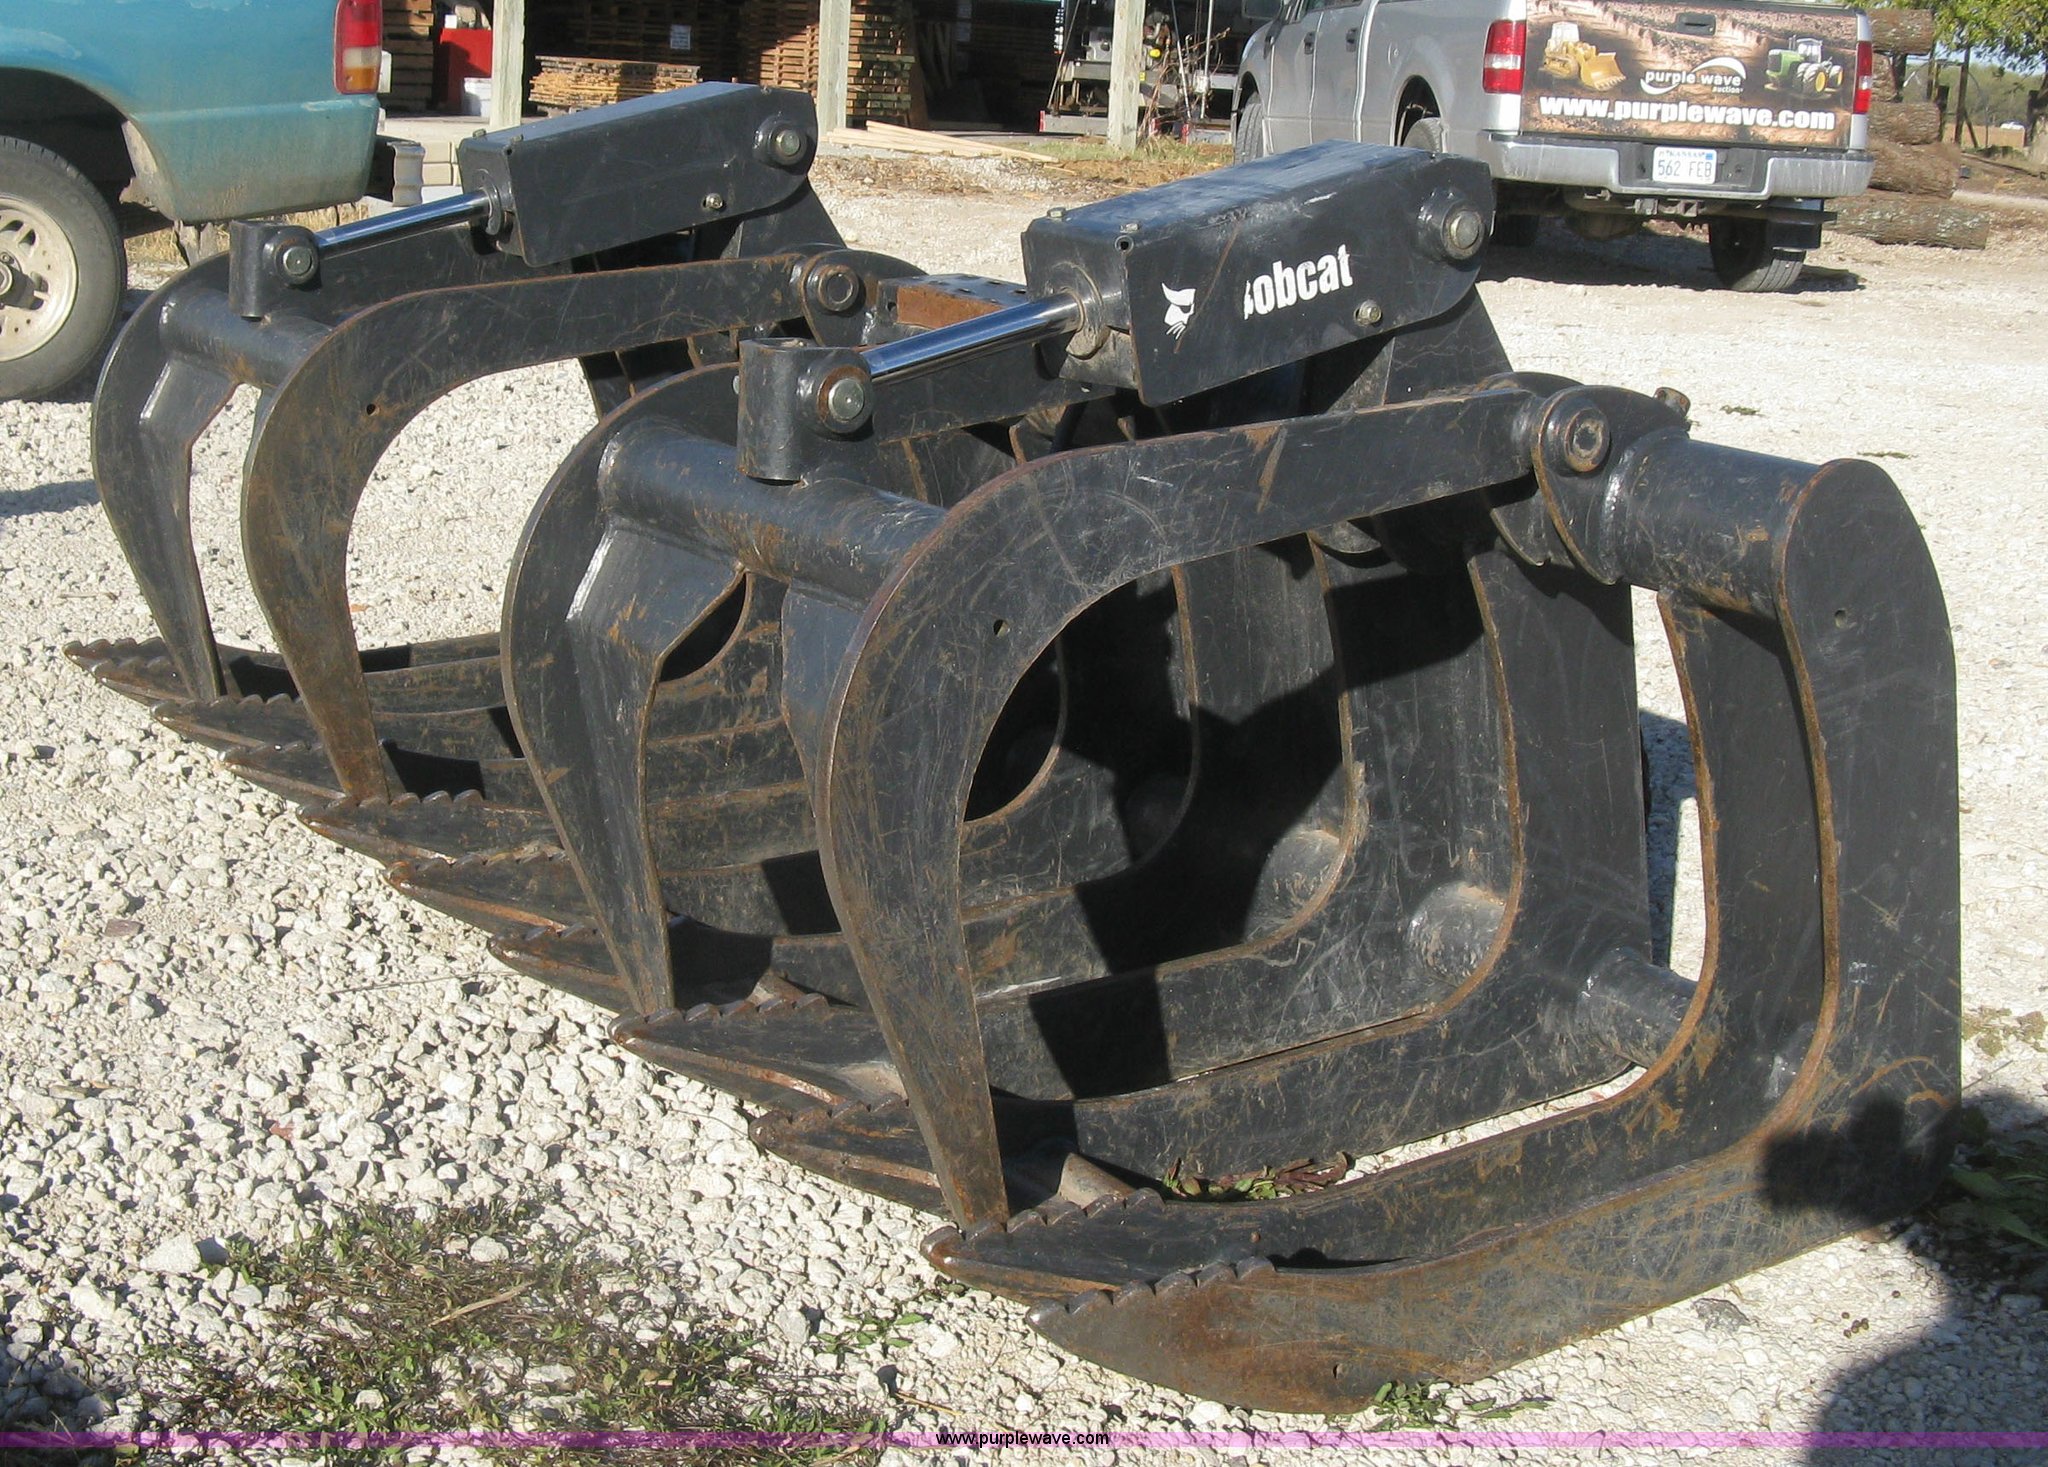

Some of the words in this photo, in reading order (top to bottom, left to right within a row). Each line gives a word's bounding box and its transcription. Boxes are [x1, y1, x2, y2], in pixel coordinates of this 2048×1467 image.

[1645, 70, 1696, 85] purple
[1701, 73, 1741, 87] wave
[1539, 96, 1836, 130] www.purplewave.com
[1658, 159, 1681, 177] 562
[1688, 161, 1712, 178] FEB
